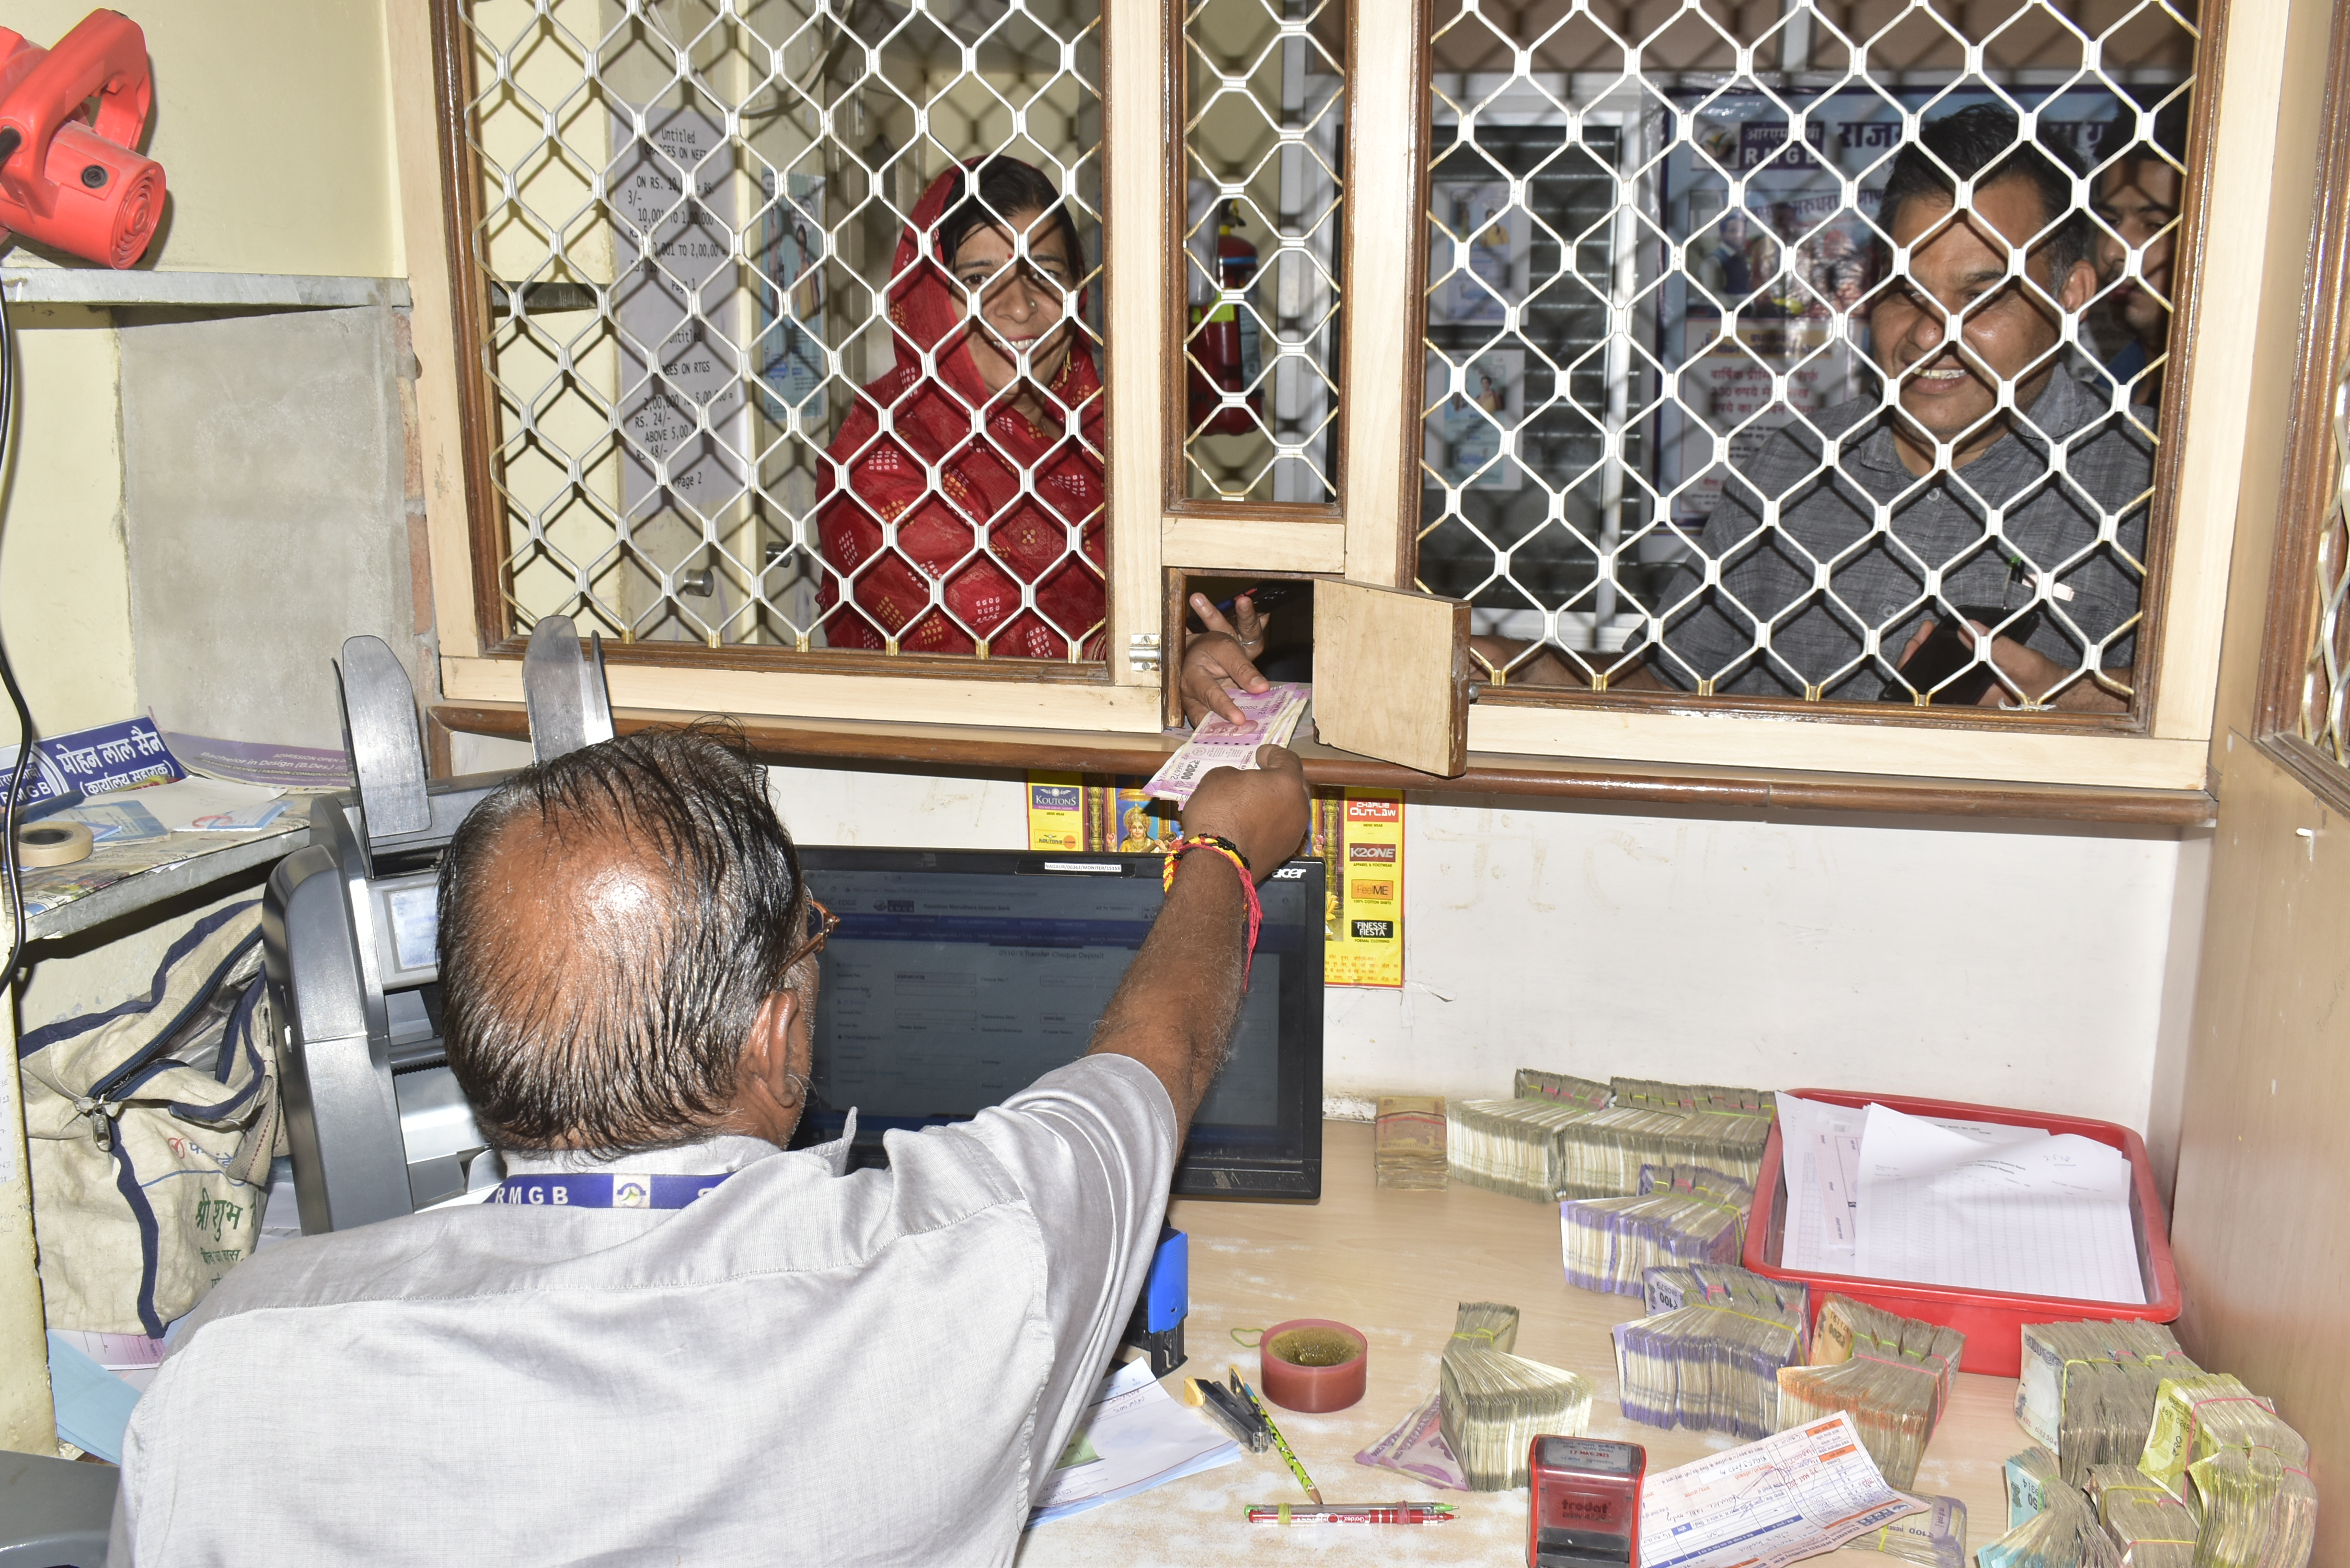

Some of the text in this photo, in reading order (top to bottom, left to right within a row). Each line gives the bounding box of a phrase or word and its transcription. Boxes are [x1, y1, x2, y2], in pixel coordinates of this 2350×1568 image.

[662, 129, 696, 144] Untitled
[679, 148, 688, 158] ON
[691, 149, 707, 160] NEFT
[636, 176, 647, 188] ON
[650, 176, 663, 189] RS.
[628, 190, 642, 206] 3/-
[682, 211, 713, 226] 1,00,000
[678, 244, 687, 255] TO
[690, 243, 719, 259] 2,00,00
[691, 278, 696, 290] 1
[682, 361, 710, 374] ON RTGS
[635, 411, 671, 429] RS. 24/-
[644, 430, 667, 444] ABOVE
[677, 472, 702, 489] Page 2
[56, 725, 165, 774] मोहन लाल सैन
[200, 752, 248, 764] Bachelor
[259, 759, 293, 770] Design
[295, 762, 335, 771] (B.Des.)
[272, 753, 317, 762] ADMISSION
[202, 759, 232, 769] FASHION
[232, 765, 257, 773] DESIGN
[1170, 762, 1185, 780] 836672
[1180, 759, 1200, 780] ₹2000
[79, 771, 130, 798] (कार्यालय
[1035, 795, 1076, 806] KOUTONS
[1350, 807, 1396, 816] OUTLAW
[1350, 847, 1395, 858] K2ONE
[1271, 868, 1306, 879] acer
[1357, 885, 1388, 895] FeelME
[1078, 952, 1104, 960] Deposit
[213, 1199, 244, 1242] शुभ
[2175, 1416, 2196, 1438] 02487
[2034, 1425, 2058, 1447] 632504
[1799, 1472, 1810, 1481] MAY
[2023, 1478, 2039, 1496] 9314
[1561, 1499, 1608, 1514] trodat
